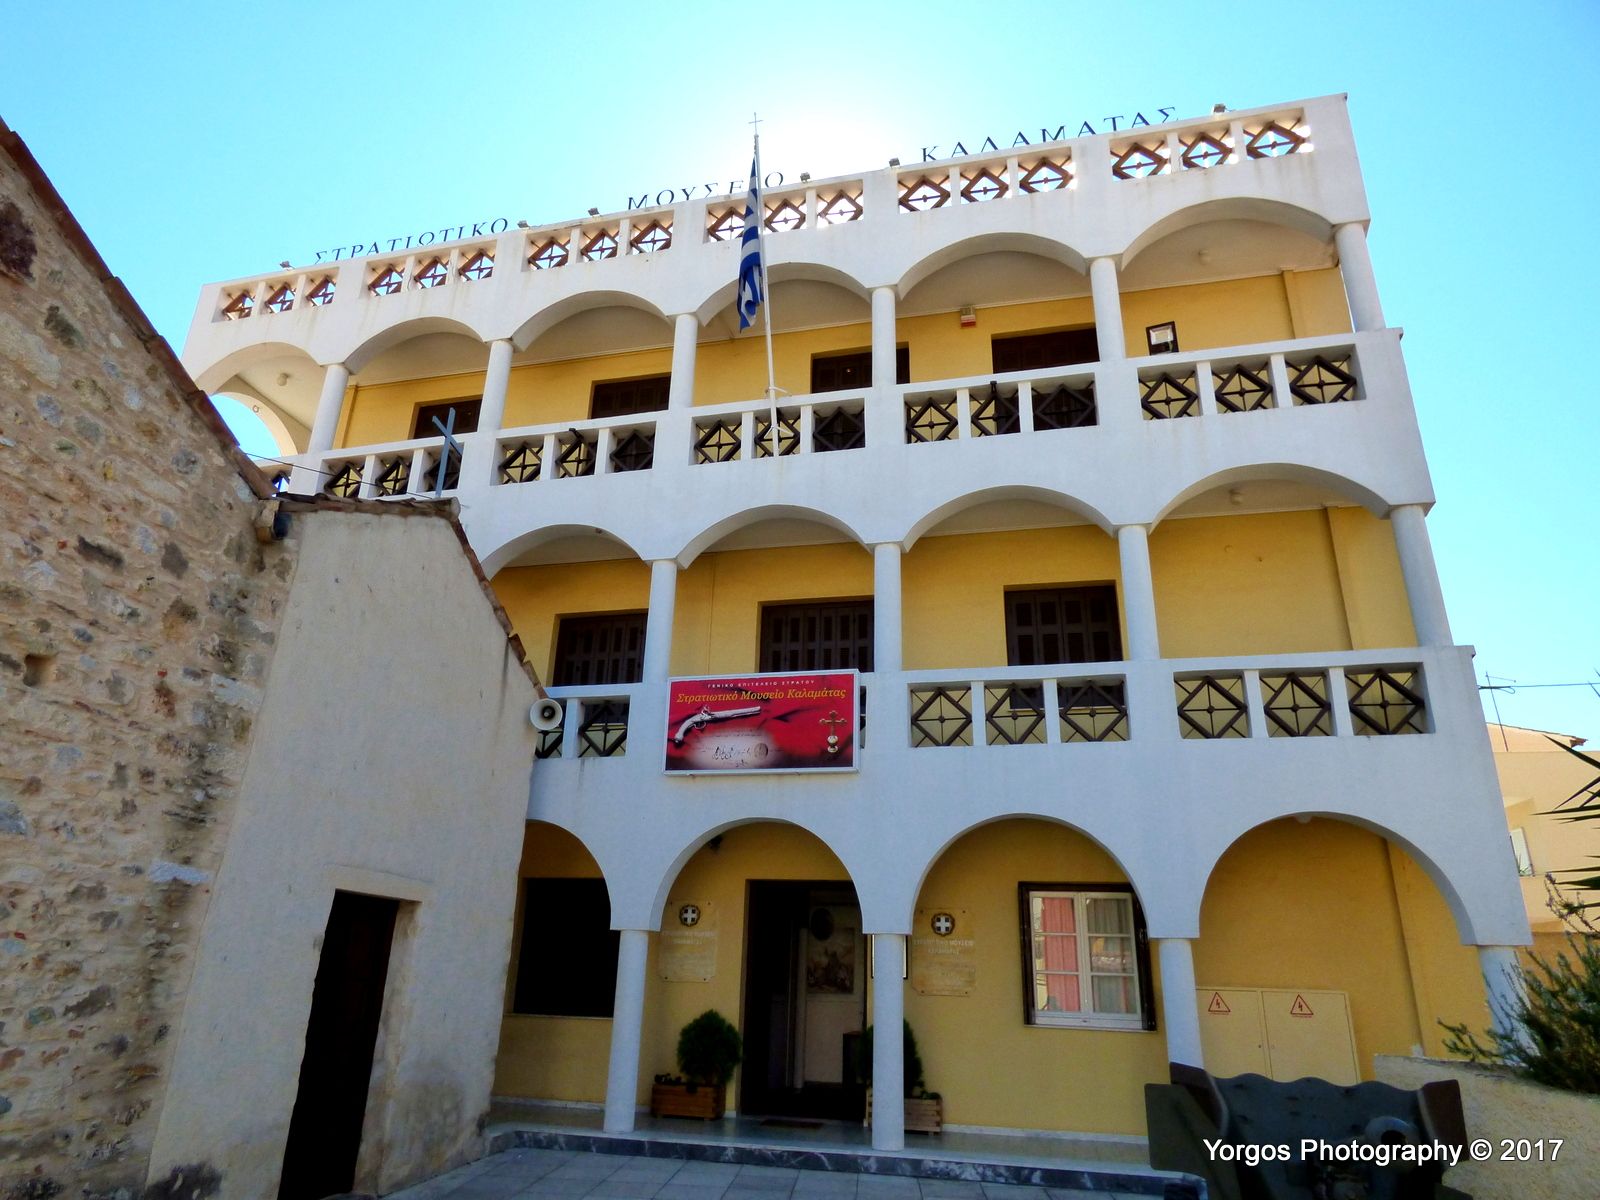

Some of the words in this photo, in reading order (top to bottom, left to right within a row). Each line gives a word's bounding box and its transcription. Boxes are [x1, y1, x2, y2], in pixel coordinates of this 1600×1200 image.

[314, 217, 509, 265] ΣΤΡΑΤΙΩΤΙΚΟ
[627, 171, 784, 211] ΜΟΥΣΕΟ
[920, 106, 1179, 162] ΚΑΛΑΜΑΤΑΣ
[676, 691, 738, 704] Στρατιωτικό
[740, 690, 785, 701] Μουσείο
[787, 688, 847, 700] Καλαμάτας
